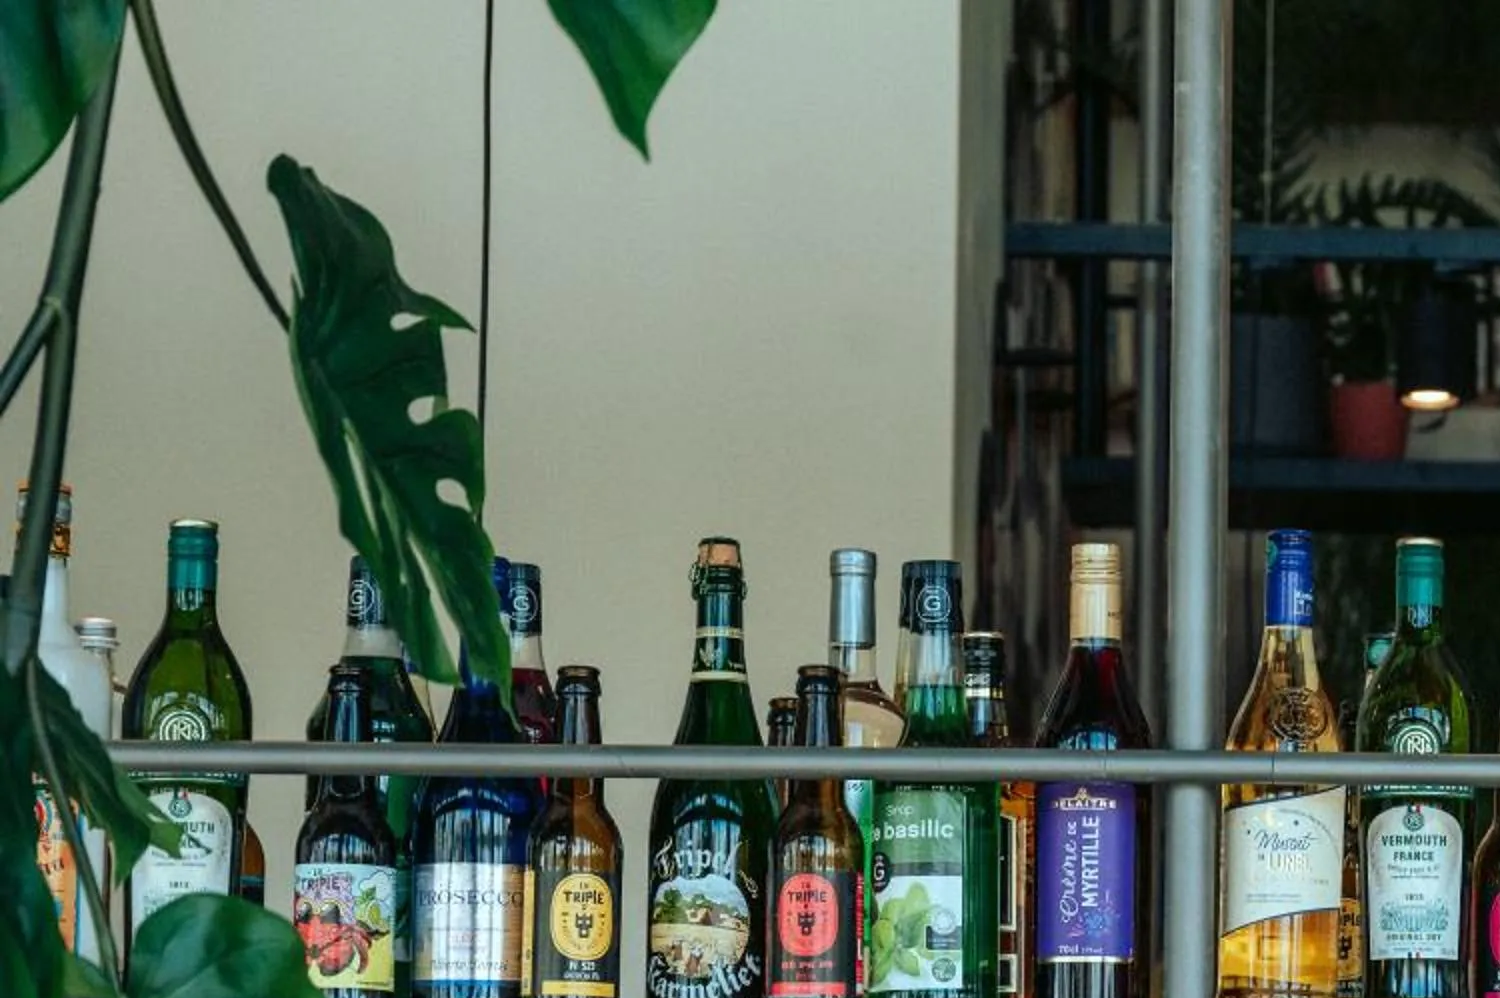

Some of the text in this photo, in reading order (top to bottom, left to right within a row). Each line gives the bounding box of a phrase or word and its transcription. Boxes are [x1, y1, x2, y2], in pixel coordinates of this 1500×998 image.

[883, 819, 954, 840] basilic
[1381, 834, 1448, 848] VERMOUTH
[1082, 816, 1099, 908] MYRTILLE
[1392, 850, 1435, 862] FRANCE
